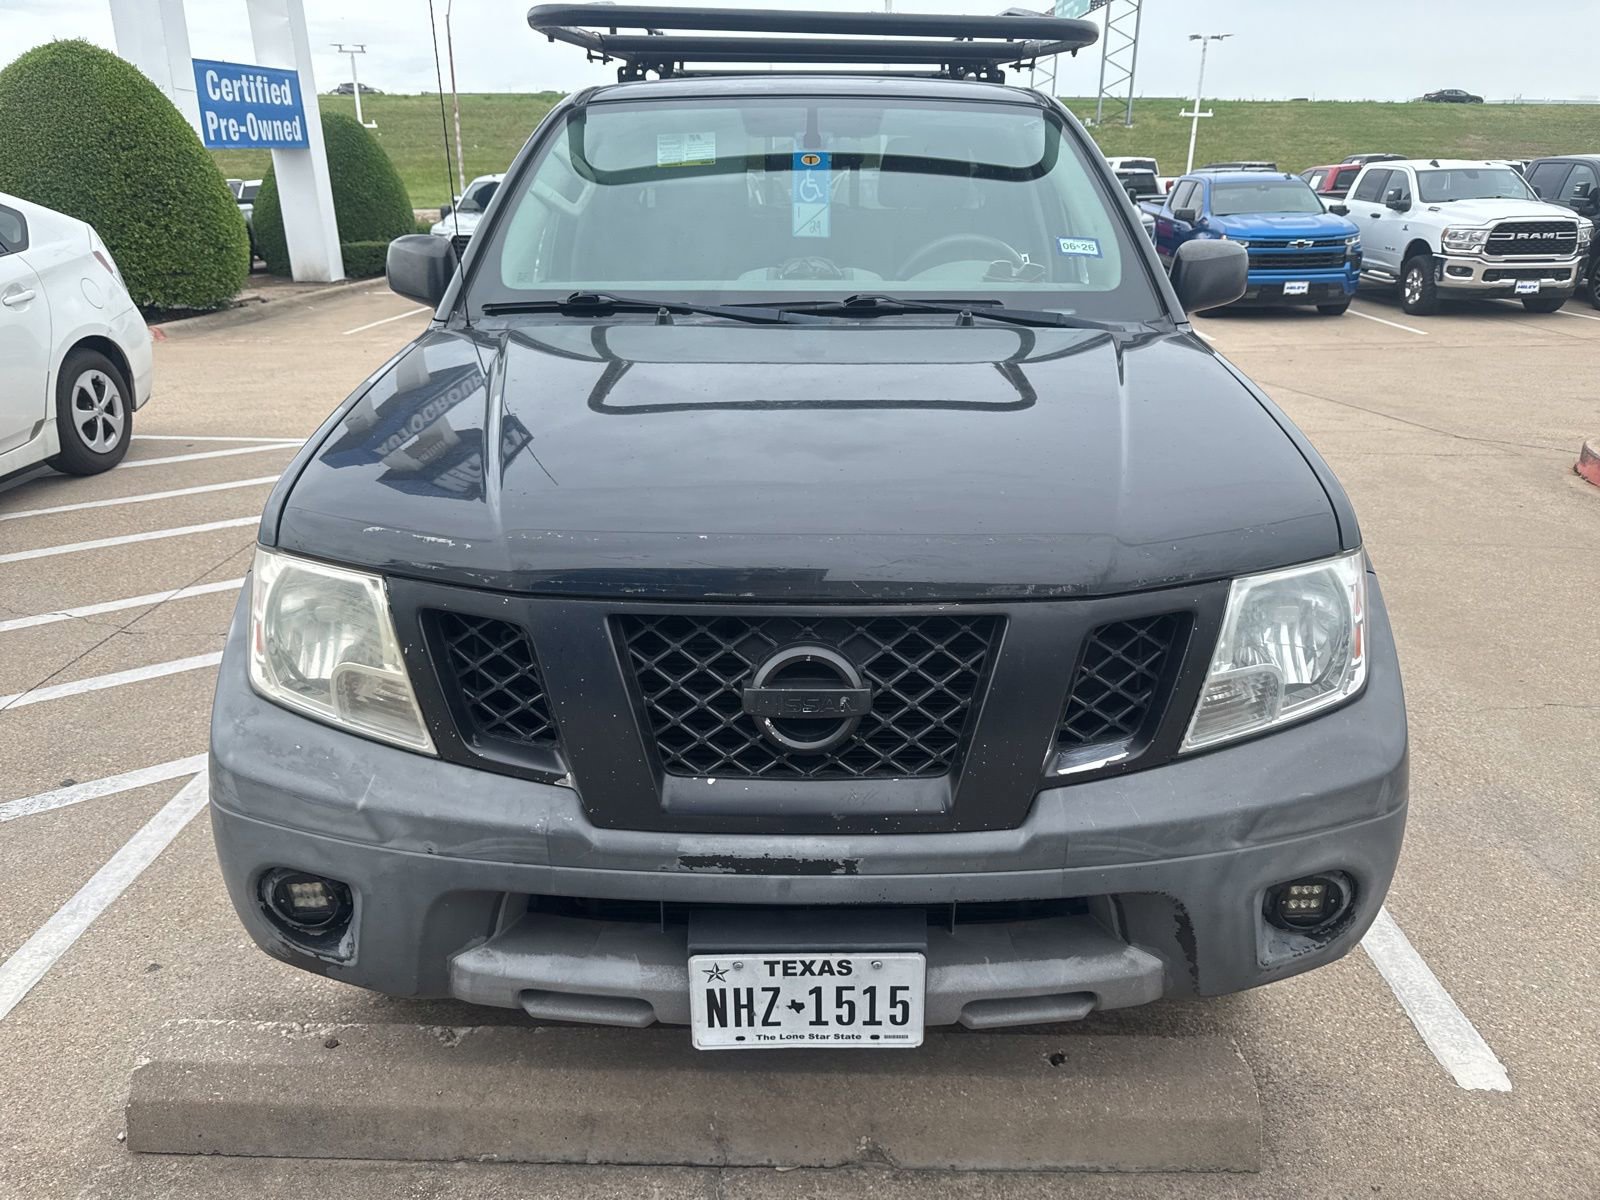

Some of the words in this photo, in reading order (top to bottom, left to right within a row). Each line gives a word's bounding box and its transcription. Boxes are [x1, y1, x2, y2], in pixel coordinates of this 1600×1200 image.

[205, 69, 293, 105] Certified
[205, 111, 303, 141] Pre-Owned
[1516, 232, 1556, 240] RAM
[750, 695, 859, 713] ISSAN
[763, 959, 853, 977] TEXAS
[705, 986, 782, 1028] NHZ
[808, 985, 910, 1026] 1515
[755, 1033, 776, 1041] The
